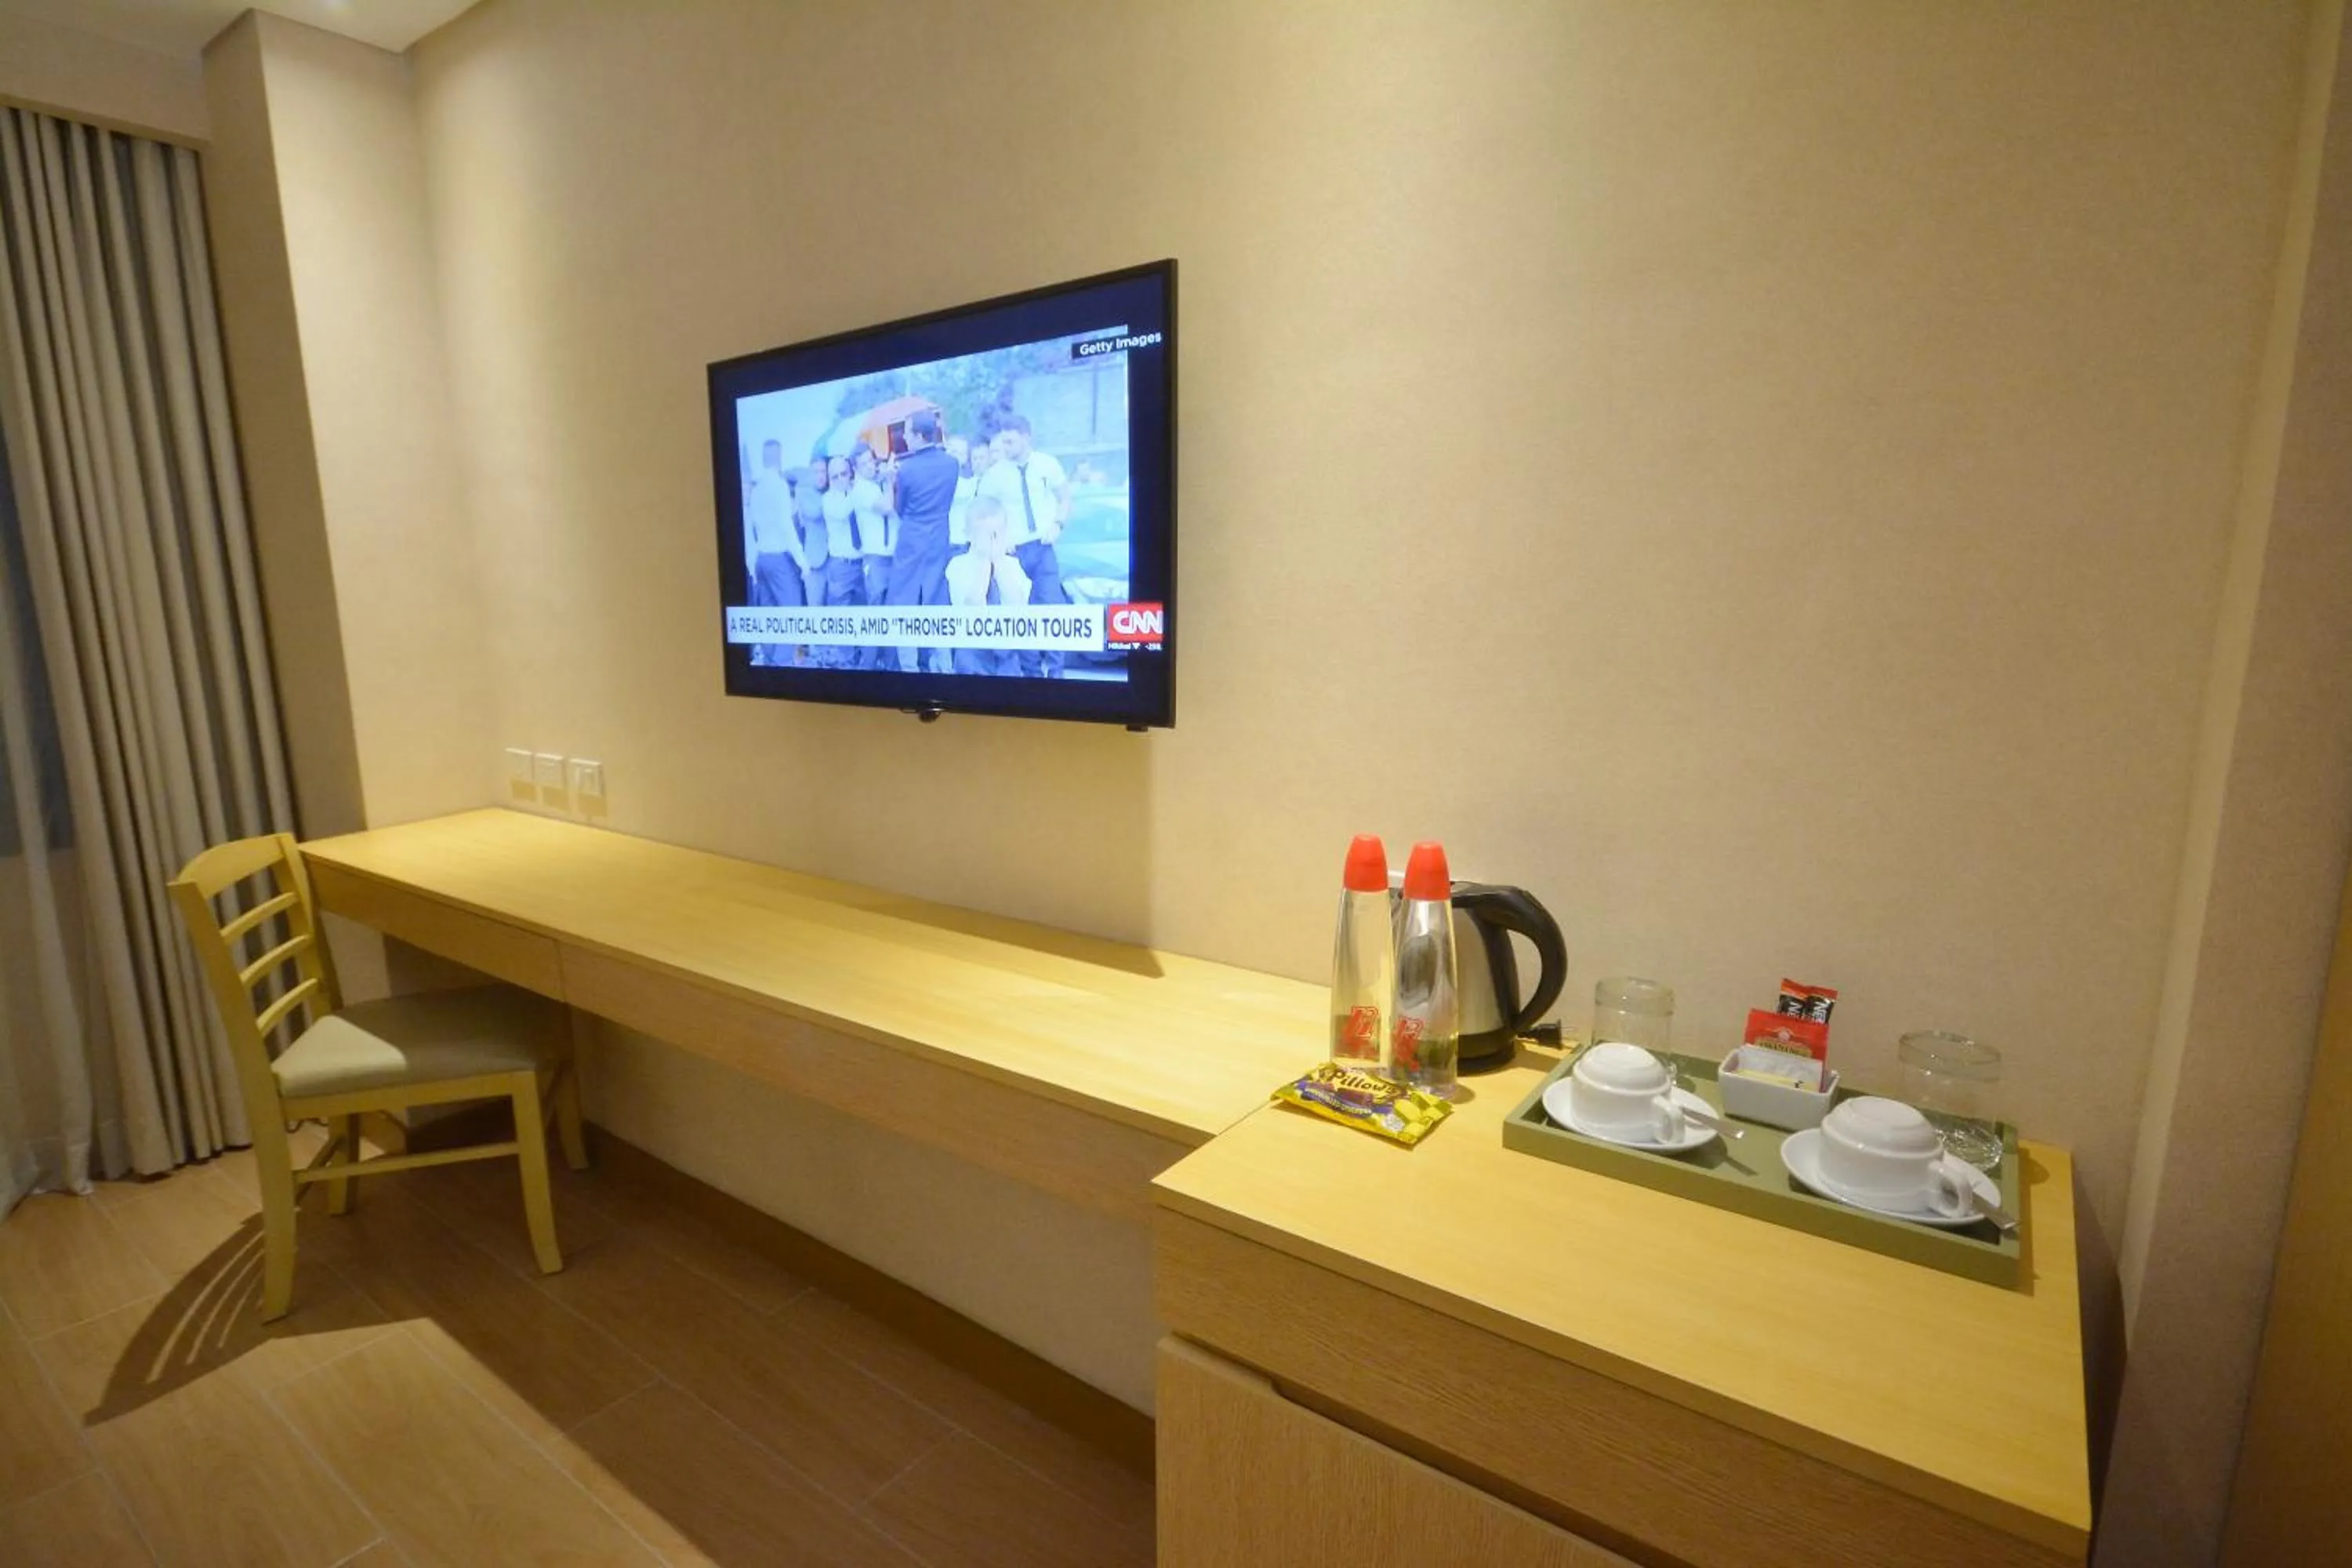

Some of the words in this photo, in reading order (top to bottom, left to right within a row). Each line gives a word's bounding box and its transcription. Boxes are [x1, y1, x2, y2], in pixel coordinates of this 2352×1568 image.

[1080, 340, 1112, 355] Getty
[1116, 332, 1161, 347] Images
[731, 617, 738, 633] A
[739, 617, 764, 633] REAL
[766, 617, 818, 634] POLITICAL
[820, 617, 857, 639] CRISIS,
[860, 618, 889, 635] AMID
[892, 618, 961, 636] "THRONES"
[966, 618, 1037, 637] LOCATION
[1041, 618, 1092, 638] TOURS
[1112, 610, 1163, 634] CNN
